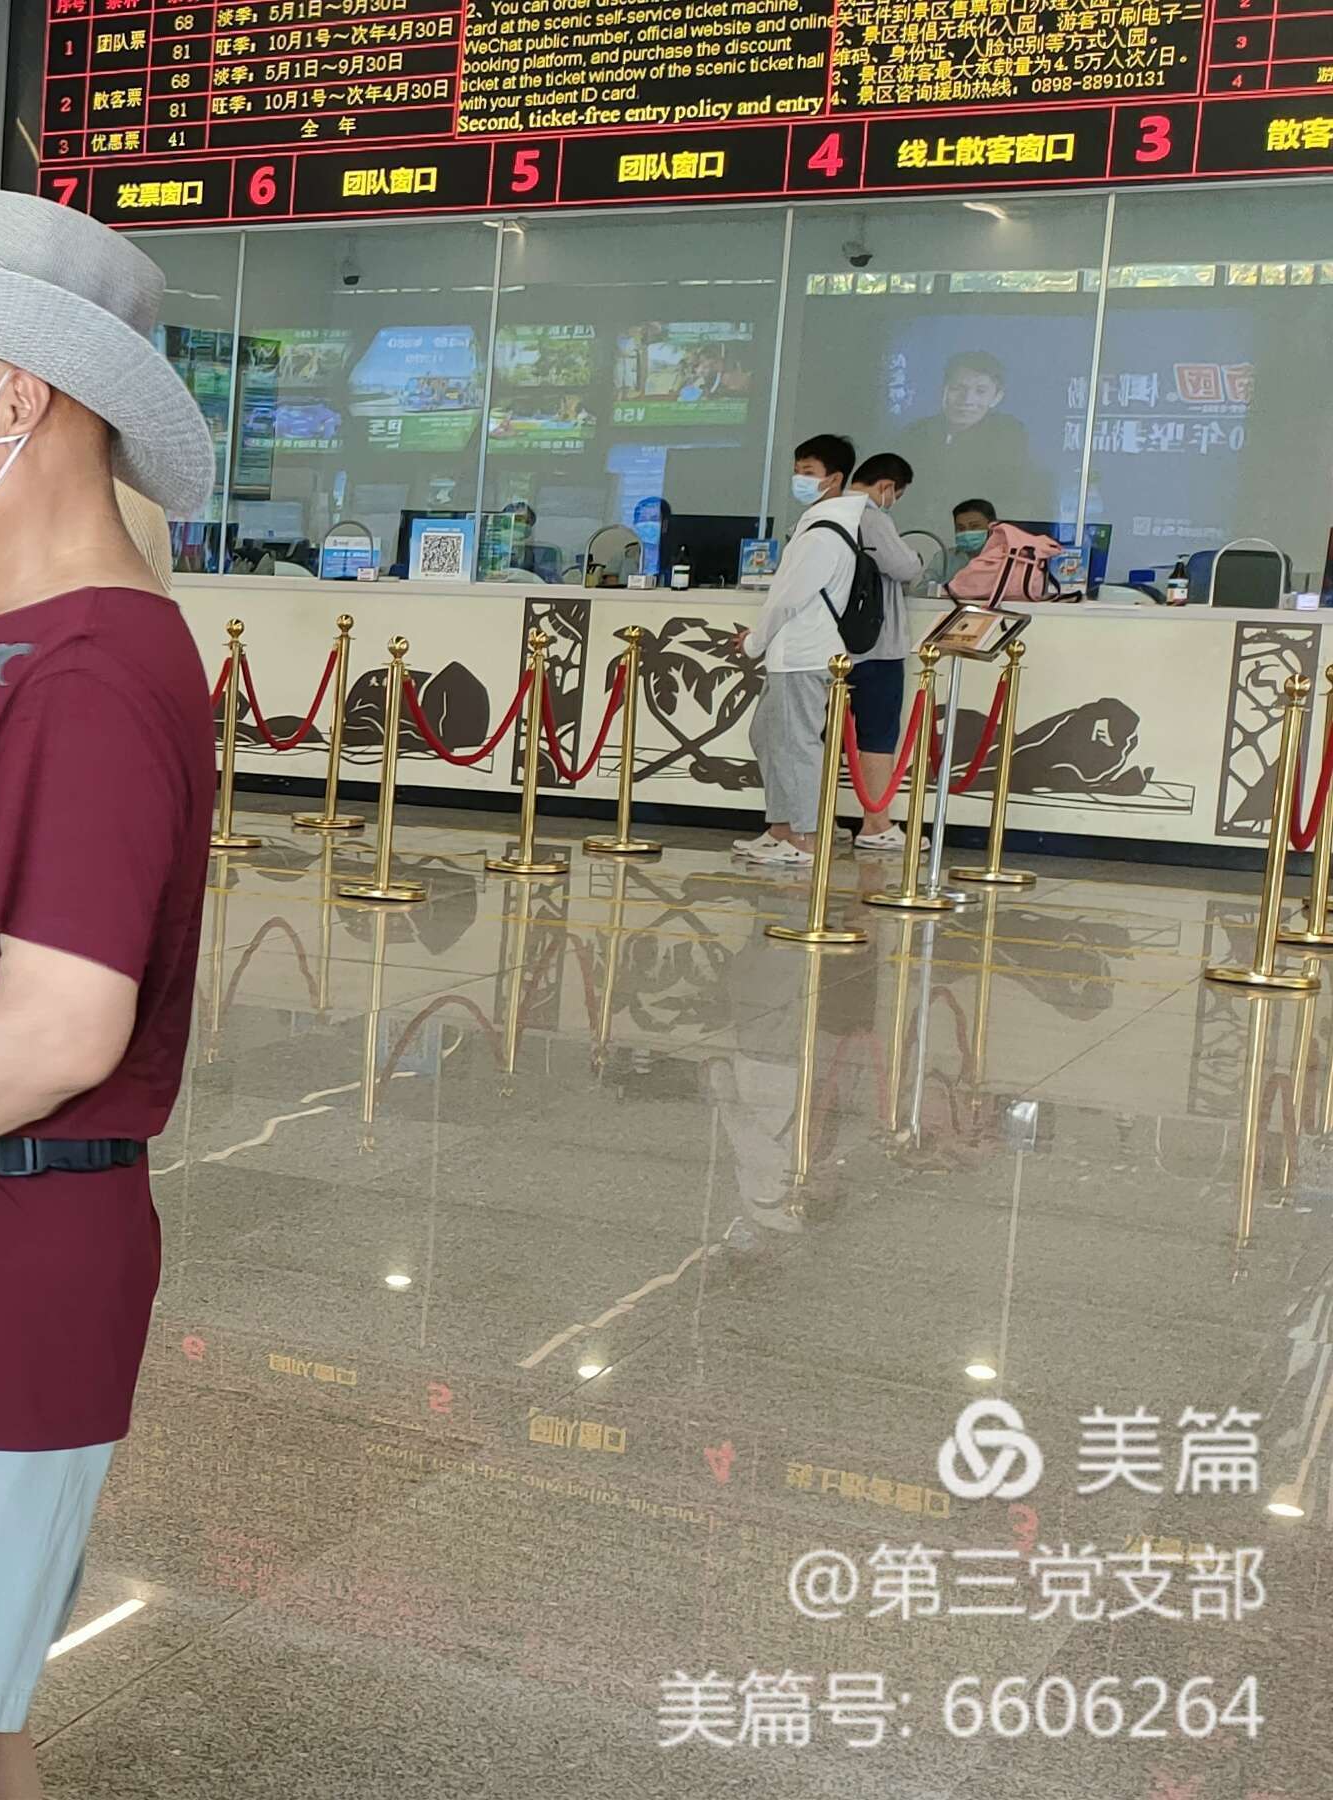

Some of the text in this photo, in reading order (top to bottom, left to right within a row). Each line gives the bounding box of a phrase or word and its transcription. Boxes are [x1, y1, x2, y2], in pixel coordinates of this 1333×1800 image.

[492, 0, 519, 16] You
[522, 0, 549, 13] can
[174, 15, 194, 31] 68
[465, 22, 497, 37] card
[500, 22, 514, 34] at
[518, 18, 540, 32] the
[544, 14, 592, 30] scenic
[596, 5, 682, 24] self-service
[685, 3, 727, 19] ticket
[96, 30, 146, 54] 团队票
[463, 39, 524, 55] WeChat
[525, 35, 569, 53] public
[573, 30, 633, 47] number,
[637, 24, 687, 41] official
[690, 19, 751, 38] website
[756, 16, 786, 33] and
[65, 40, 74, 56] 1
[172, 44, 190, 60] 81
[462, 36, 792, 75] booking platform, and purchase the discount
[171, 73, 190, 89] 68
[460, 53, 824, 93] ticket at the ticket window of the scenic ticket hall
[60, 96, 72, 113] 2
[93, 88, 143, 110] 散客票
[460, 95, 487, 111] with
[490, 96, 521, 112] your
[525, 90, 578, 106] student
[581, 88, 598, 102] ID
[169, 103, 187, 118] 81
[458, 95, 824, 132] Second, ticket-free entry policy and entry
[59, 139, 69, 154] 3
[90, 130, 141, 153] 优惠票
[168, 131, 185, 148] 41
[807, 133, 844, 177] 4
[898, 133, 1075, 169] 线上散客窗口
[1135, 115, 1171, 163] 3
[52, 150, 725, 208] 7 发票窗口 6 团队窗口 5 团队窗口
